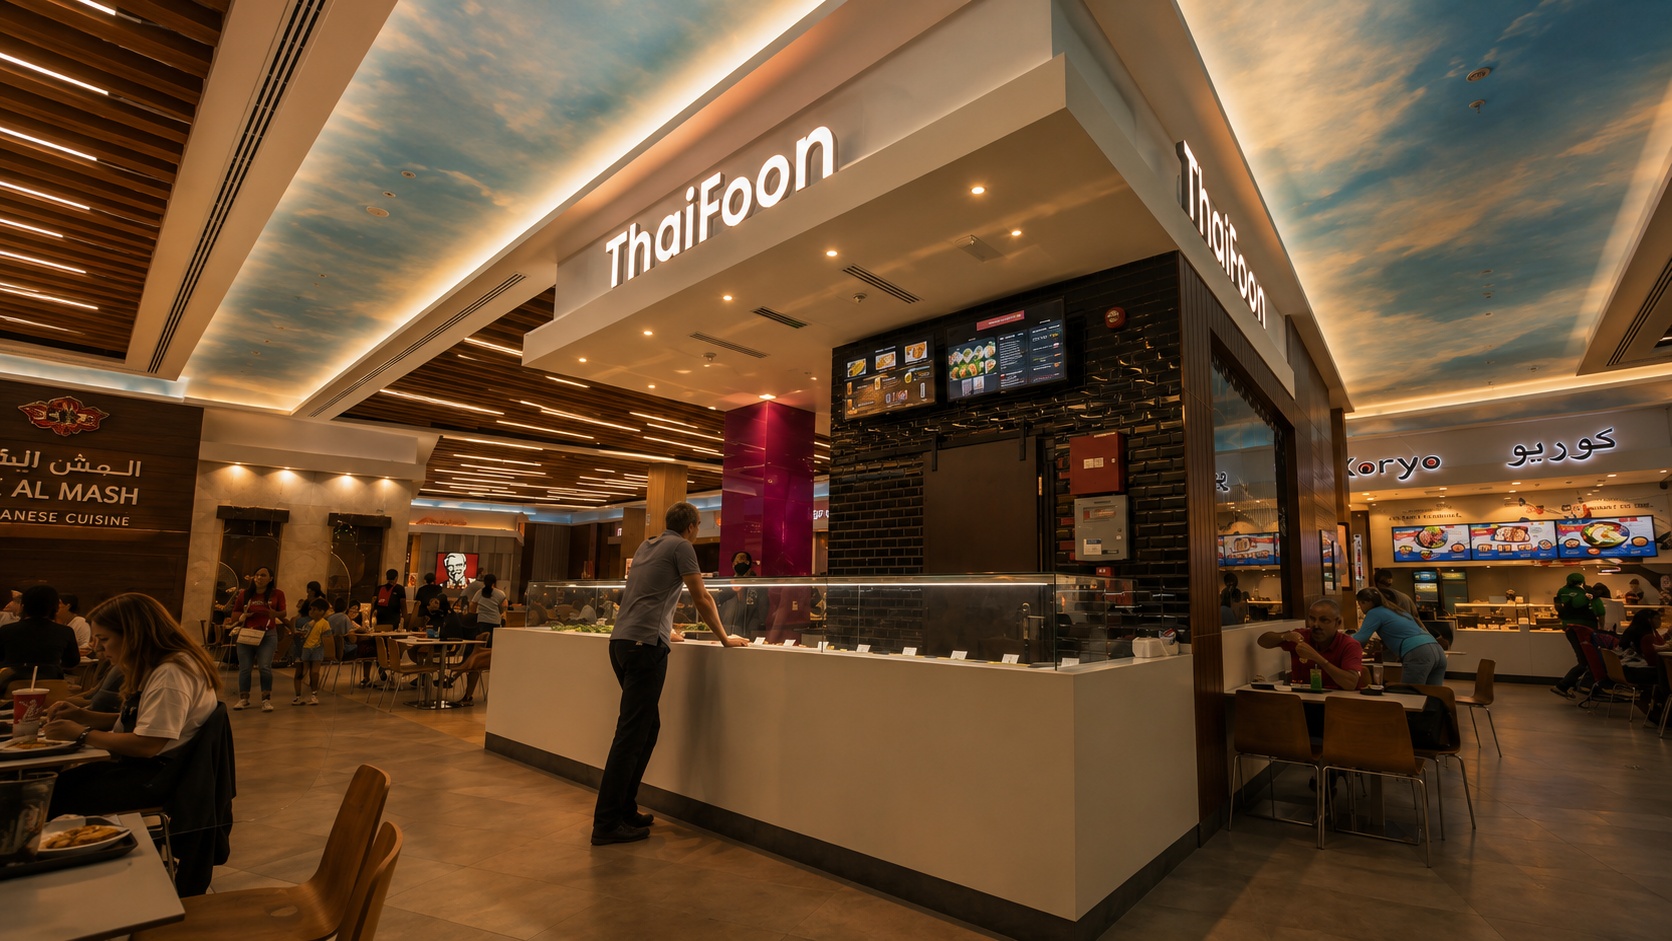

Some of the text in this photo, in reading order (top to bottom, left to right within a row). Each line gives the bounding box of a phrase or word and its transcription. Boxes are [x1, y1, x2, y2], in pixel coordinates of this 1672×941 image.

[605, 126, 835, 289] ThaiFoon
[1181, 139, 1267, 330] ThaiFoon
[1506, 426, 1617, 468] كوريو
[11, 479, 50, 500] AL
[58, 482, 139, 505] MASH
[65, 513, 130, 527] CUISINE
